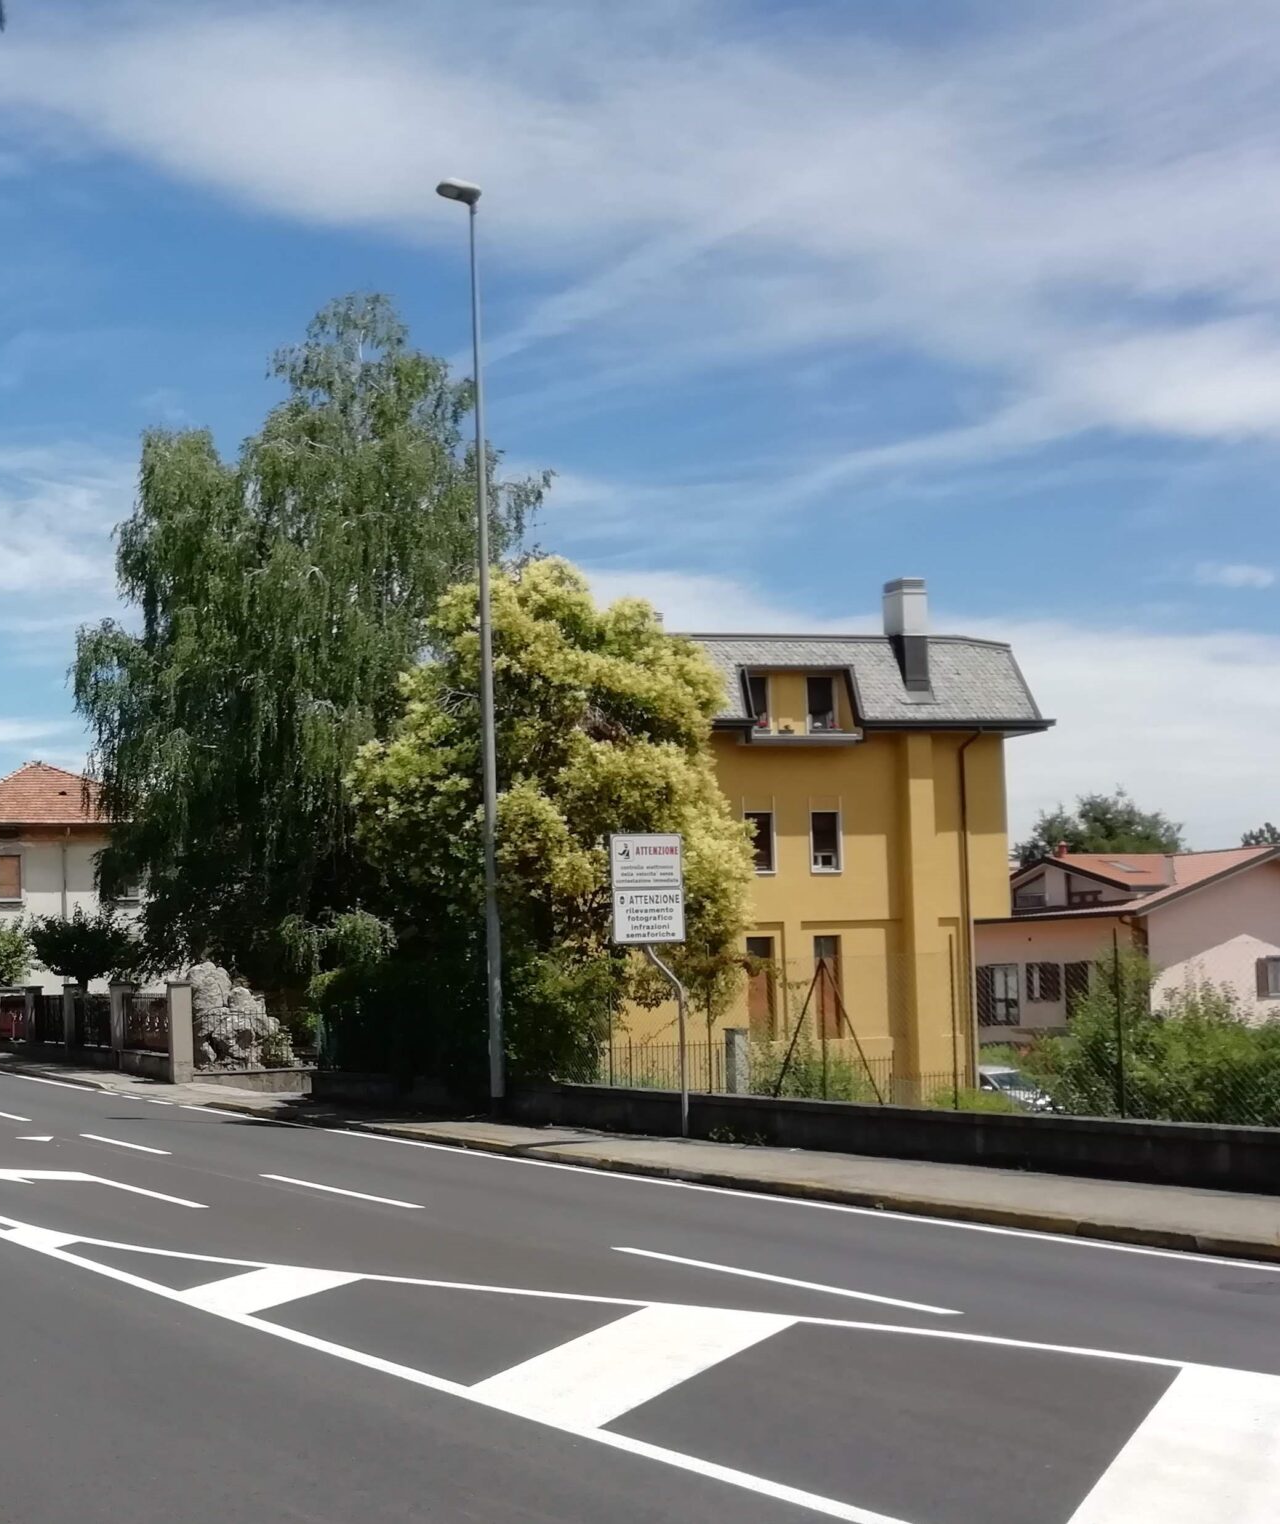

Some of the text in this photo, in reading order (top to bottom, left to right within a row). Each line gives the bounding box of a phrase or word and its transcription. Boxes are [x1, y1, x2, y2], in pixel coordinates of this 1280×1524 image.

[635, 846, 679, 856] ATTENZIONE
[629, 894, 680, 905] ATTENZIONE
[627, 914, 673, 922] fotografico
